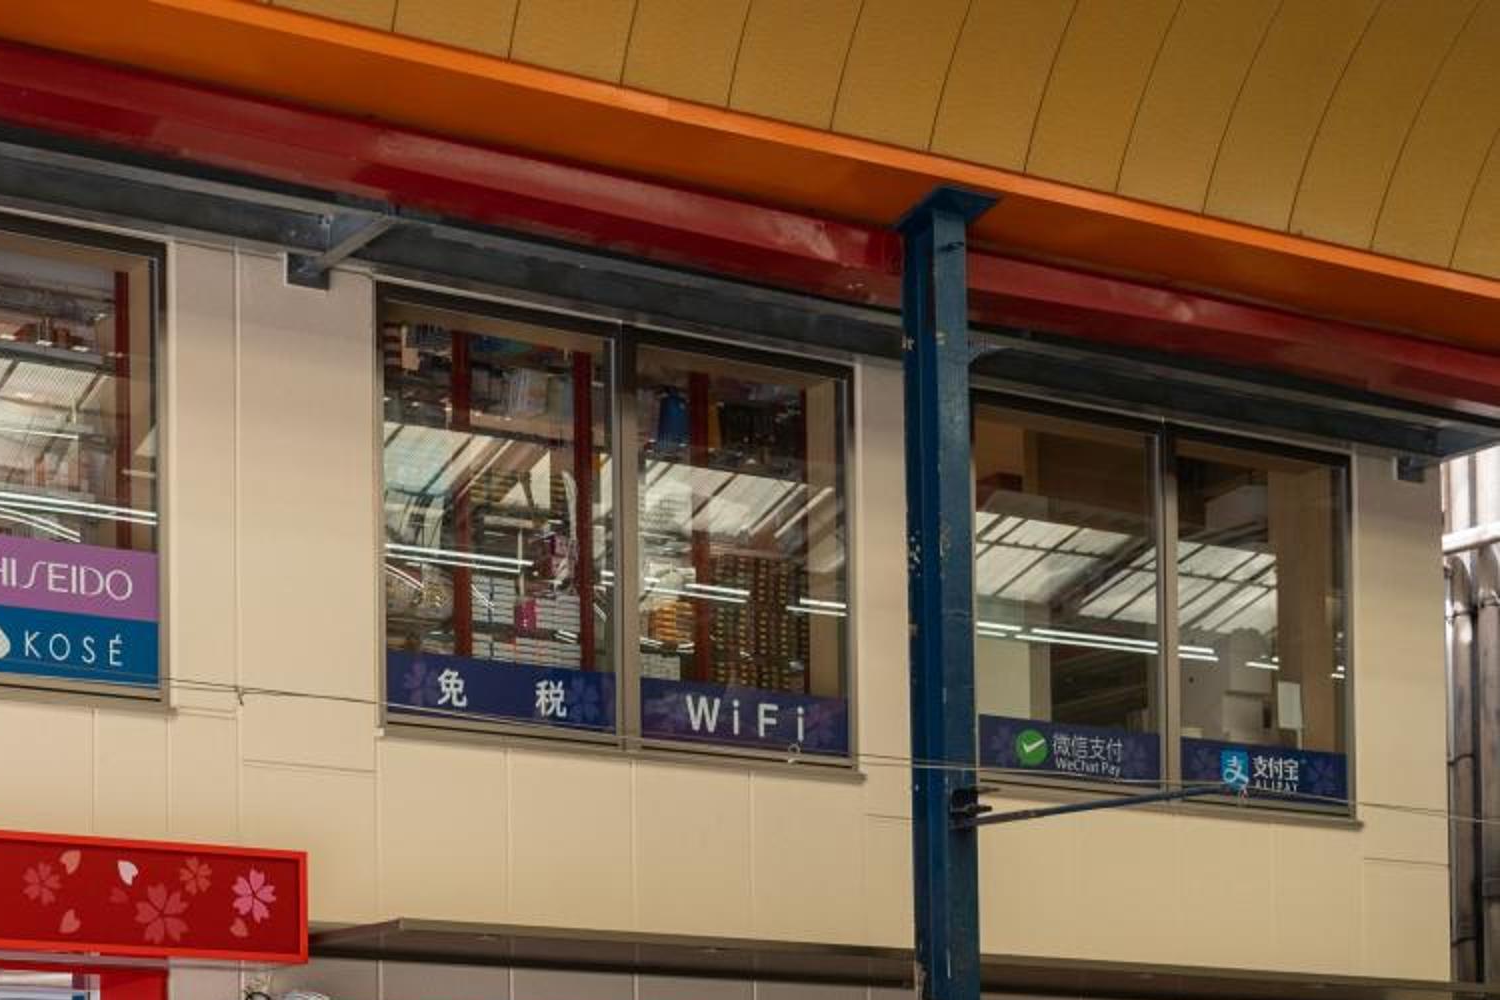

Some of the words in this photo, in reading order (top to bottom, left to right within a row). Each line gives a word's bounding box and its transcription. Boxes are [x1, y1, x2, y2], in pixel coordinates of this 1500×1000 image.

[23, 630, 125, 668] KOSÉ
[1051, 733, 1124, 763] 微信支付
[1055, 756, 1097, 776] WeChat
[1100, 761, 1123, 779] Pay
[1251, 754, 1300, 781] 支付宝
